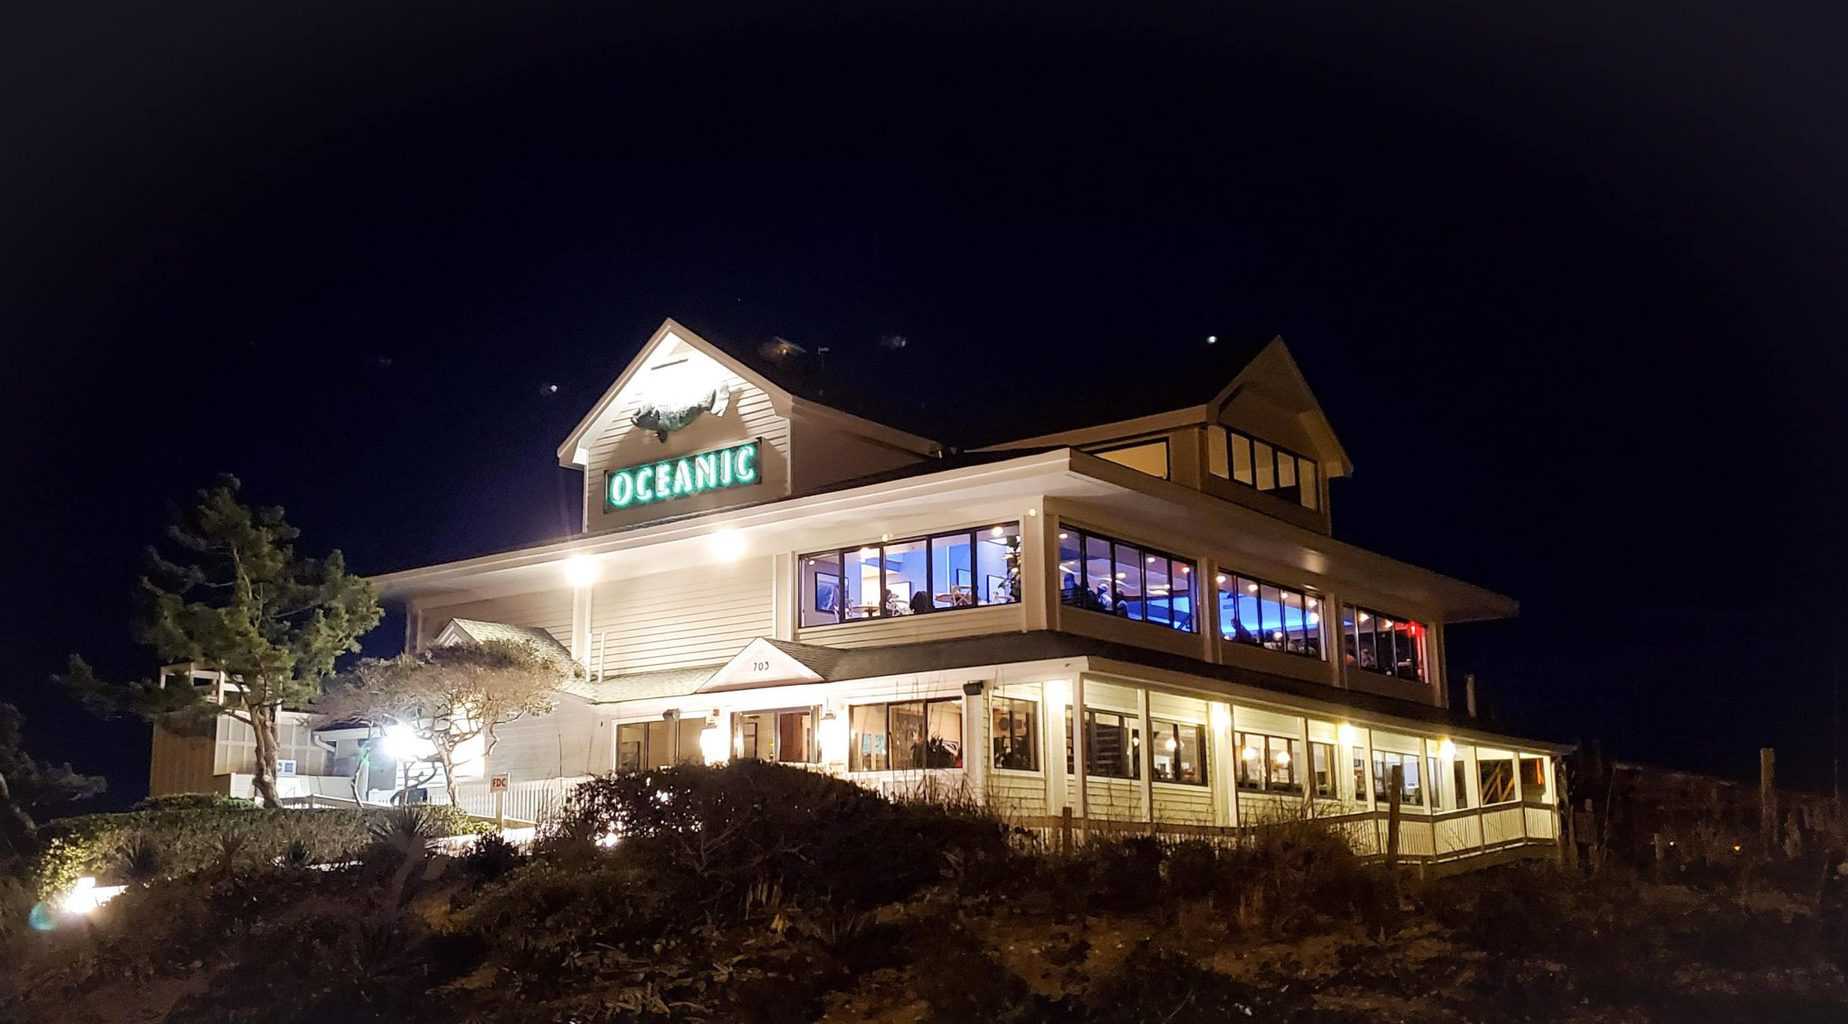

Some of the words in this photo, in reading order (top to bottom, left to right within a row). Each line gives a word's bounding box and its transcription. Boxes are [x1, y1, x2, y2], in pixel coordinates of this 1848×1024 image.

[610, 444, 756, 508] OCEANIC
[753, 661, 770, 672] 703
[492, 778, 507, 787] FDC
